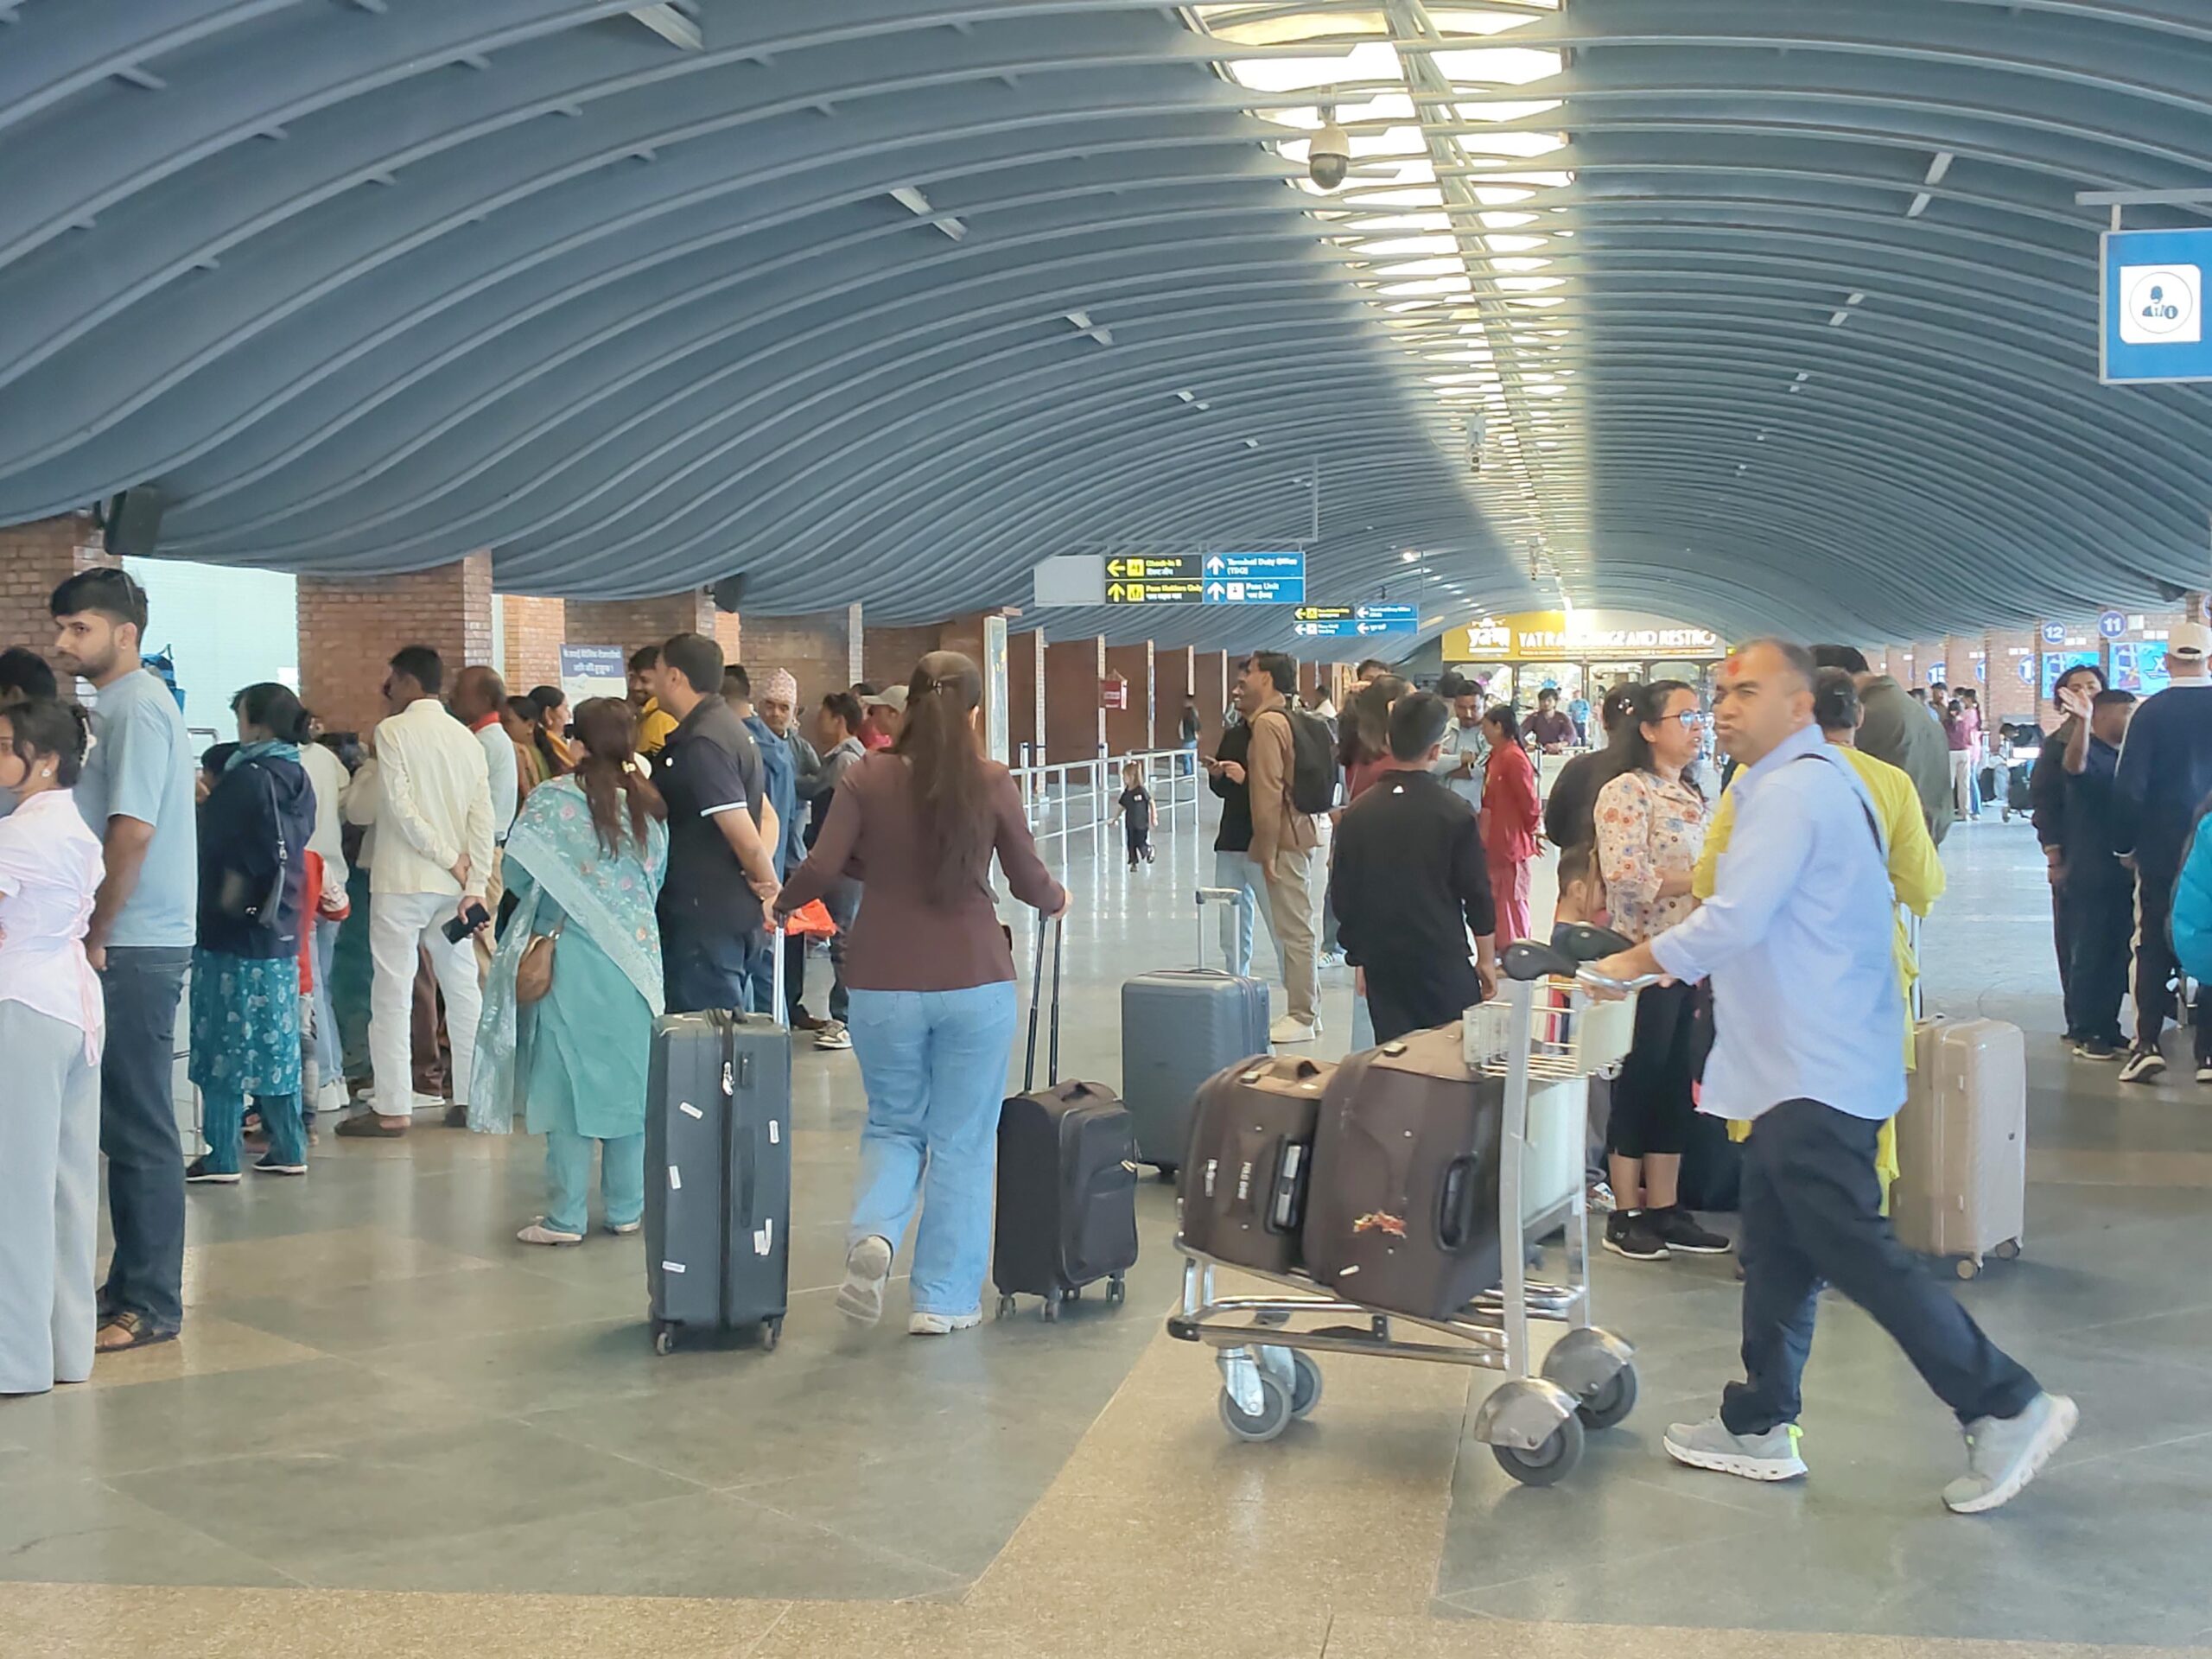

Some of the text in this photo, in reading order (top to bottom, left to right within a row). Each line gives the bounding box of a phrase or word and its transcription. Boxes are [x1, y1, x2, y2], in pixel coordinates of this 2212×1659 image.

[1258, 557, 1275, 567] Duty
[2103, 618, 2121, 632] 11
[1626, 631, 1657, 646] AND
[2045, 626, 2063, 639] 12
